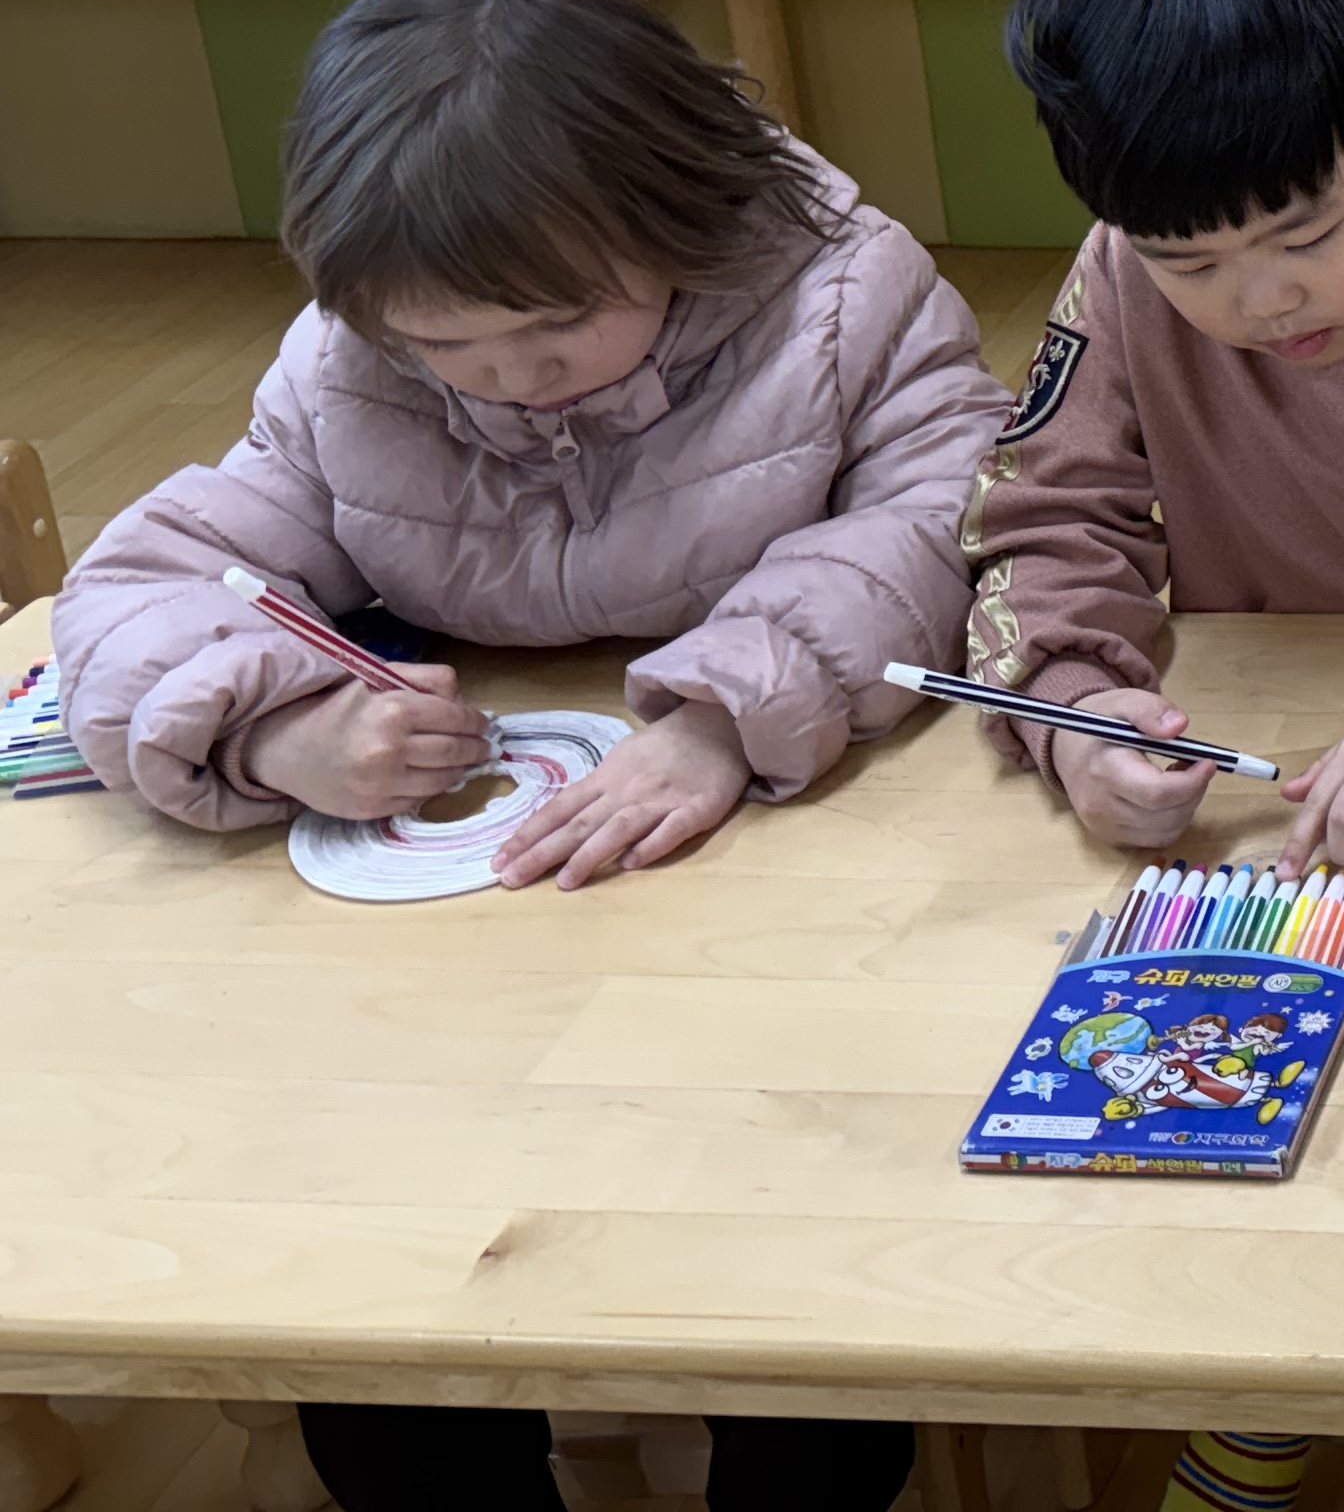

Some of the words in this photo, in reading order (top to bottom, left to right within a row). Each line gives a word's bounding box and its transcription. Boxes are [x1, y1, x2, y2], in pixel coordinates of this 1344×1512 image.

[1134, 968, 1191, 987] 슈퍼
[1190, 973, 1262, 989] 색연필
[1089, 1151, 1137, 1173] 슈퍼
[1146, 1157, 1204, 1174] 색연필
